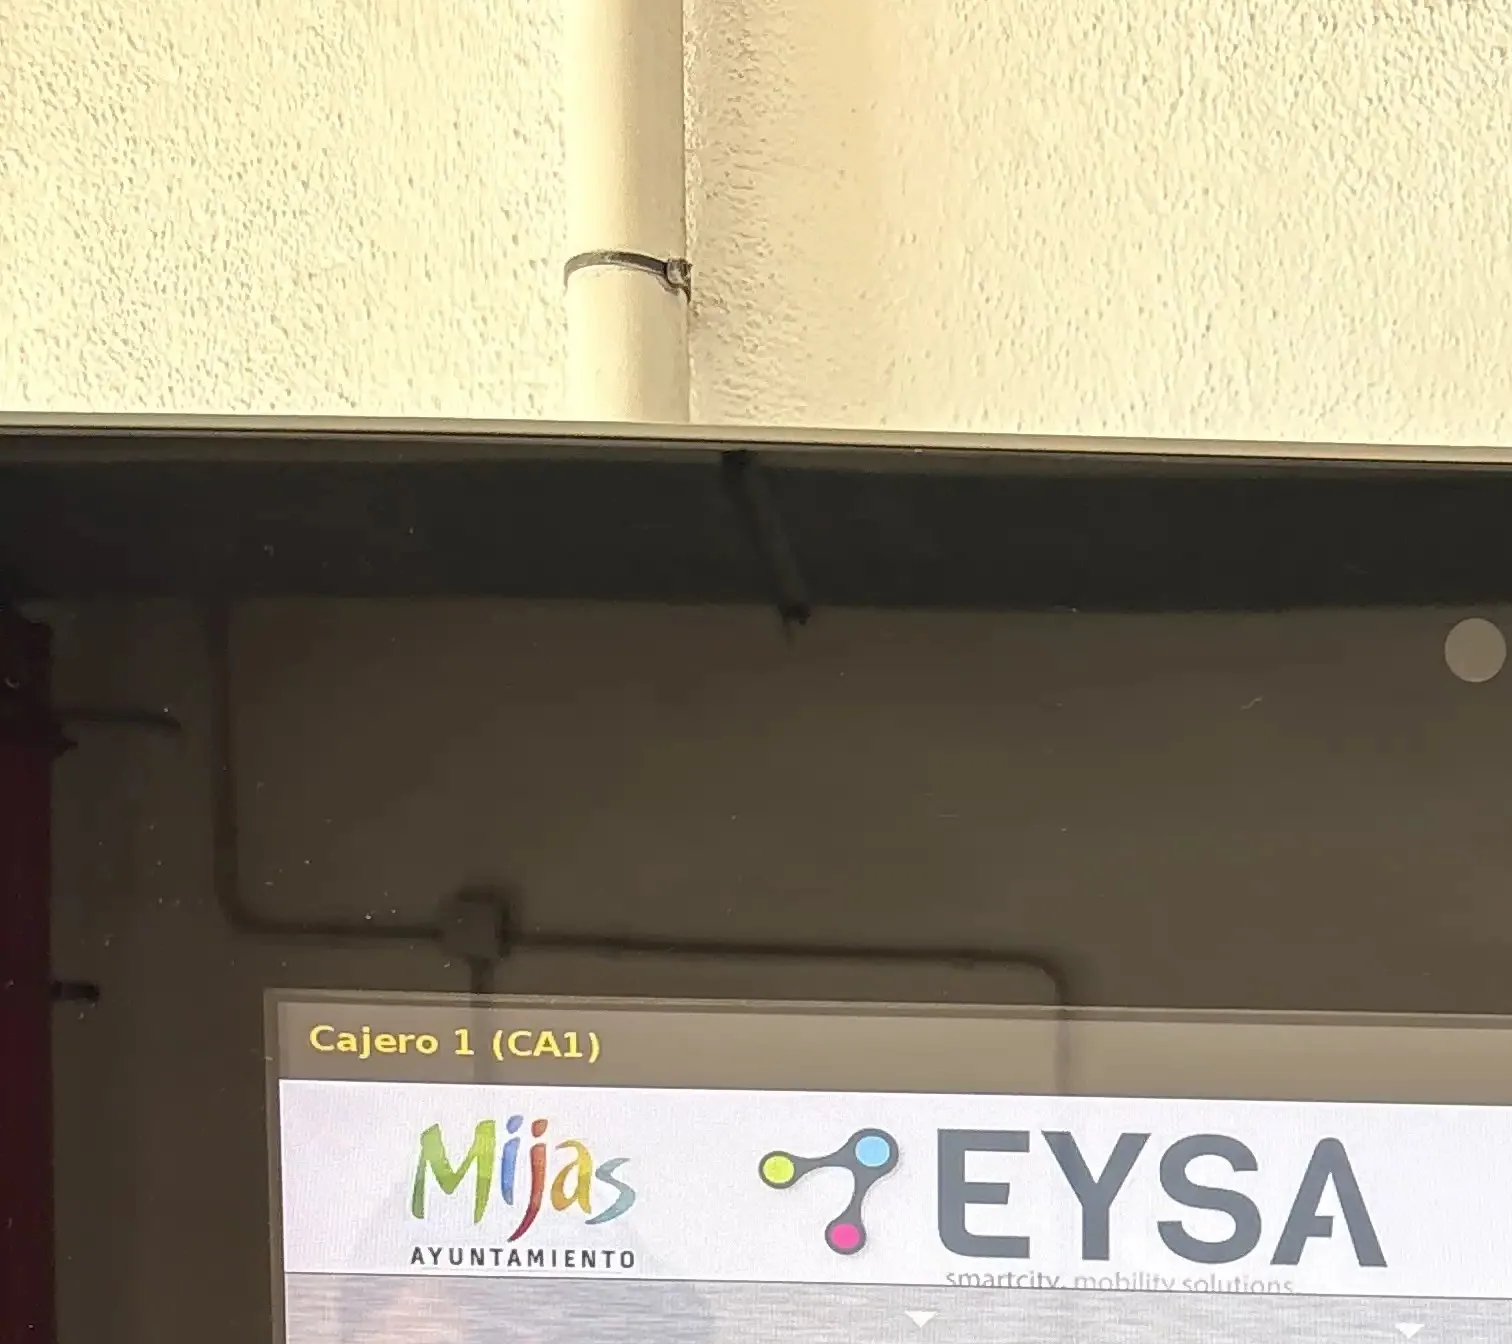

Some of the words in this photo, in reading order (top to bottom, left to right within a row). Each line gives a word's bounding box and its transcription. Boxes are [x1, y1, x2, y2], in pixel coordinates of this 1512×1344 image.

[308, 1024, 441, 1062] Cajero
[452, 1027, 476, 1056] 1
[490, 1028, 602, 1065] (CA1)
[410, 1113, 637, 1243] Mijas
[935, 1127, 1388, 1269] EYSA
[410, 1246, 637, 1269] AYUNTAMIENTO
[1074, 1273, 1175, 1292] mobility
[1181, 1274, 1294, 1294] solutions
